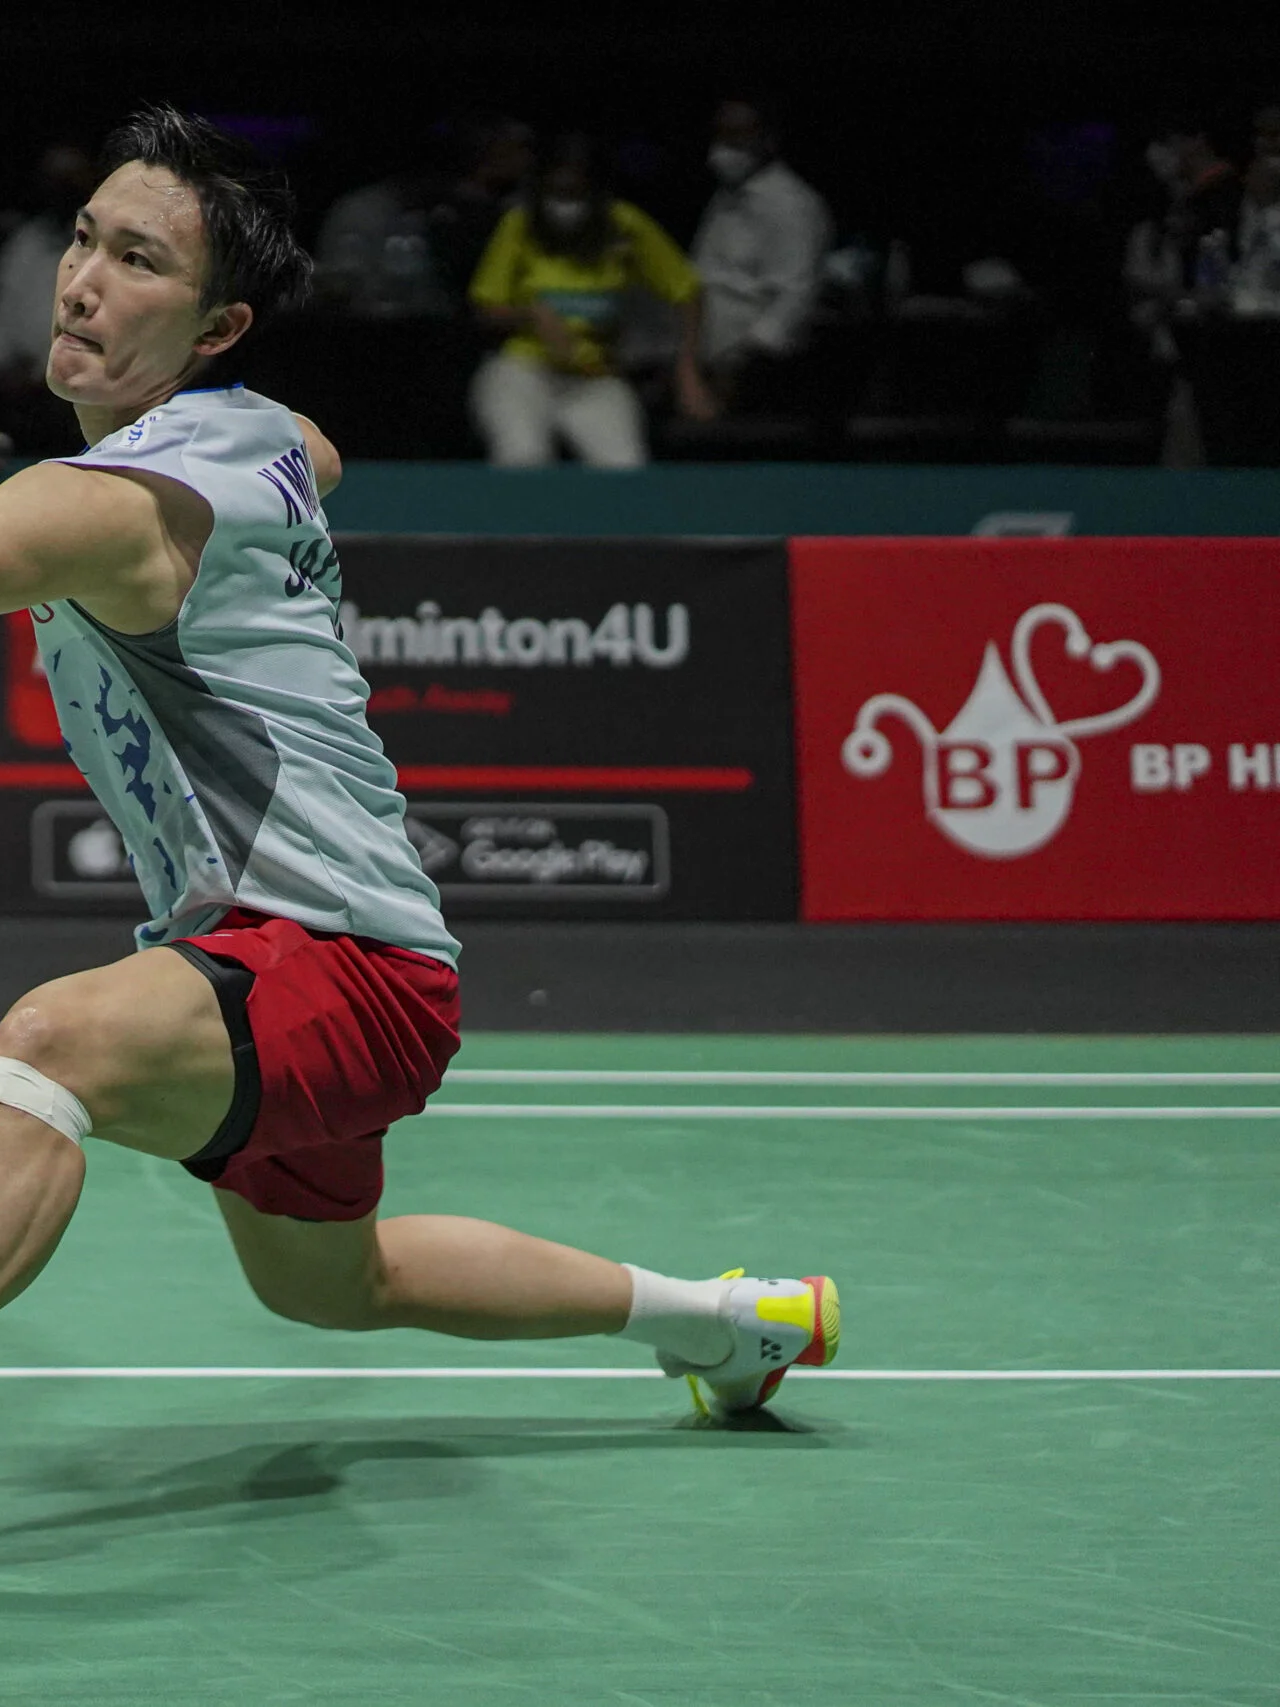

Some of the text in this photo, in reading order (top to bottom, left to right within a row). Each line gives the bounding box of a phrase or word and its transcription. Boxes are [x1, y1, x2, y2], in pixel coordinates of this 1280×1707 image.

[284, 538, 342, 597] JAP
[937, 743, 1069, 810] BP
[1131, 744, 1210, 790] BP
